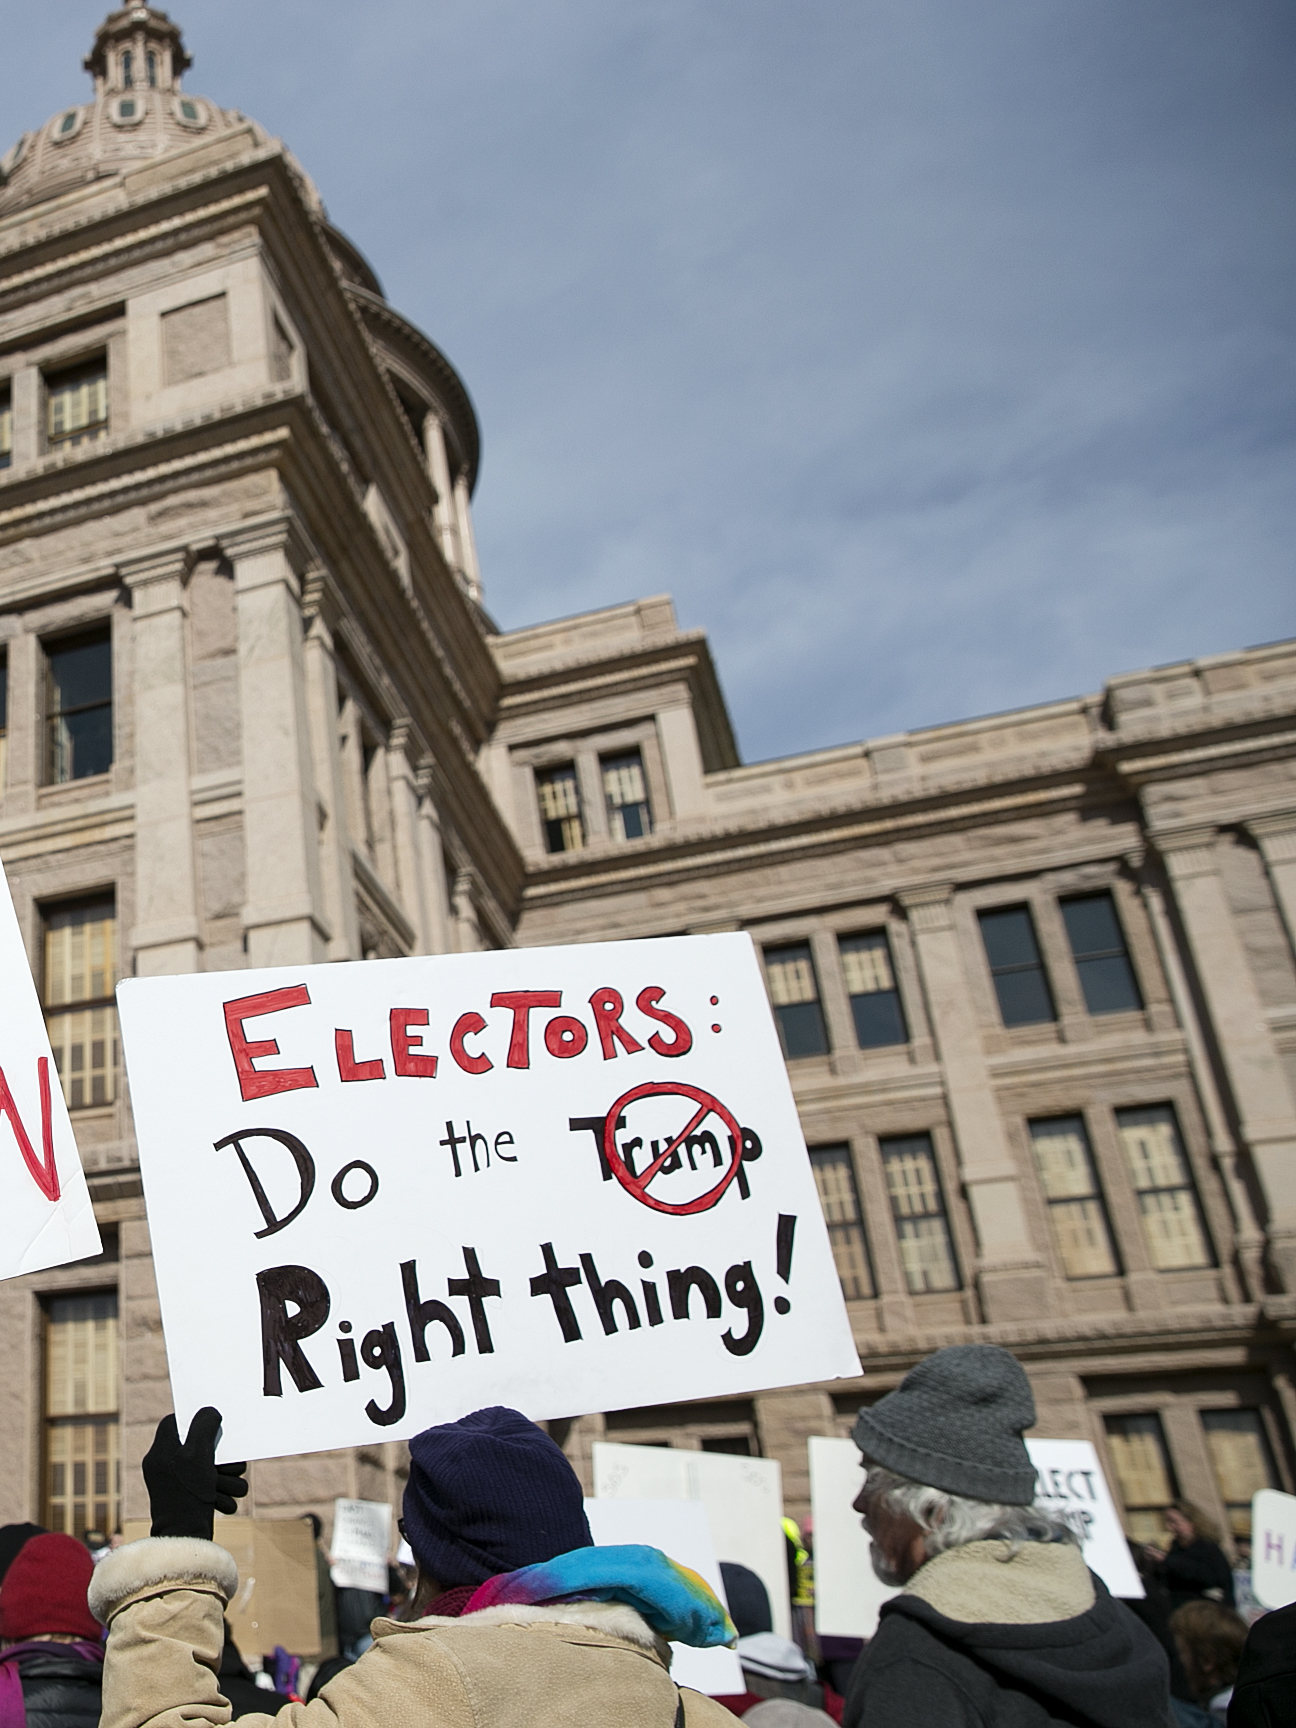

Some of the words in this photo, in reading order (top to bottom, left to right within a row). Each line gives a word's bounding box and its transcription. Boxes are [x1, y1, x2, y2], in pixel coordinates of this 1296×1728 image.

[222, 984, 722, 1102] ELECTORS:
[213, 1127, 380, 1240] Do
[439, 1120, 518, 1178] the
[568, 1115, 764, 1201] Trump
[255, 1246, 502, 1427] Right
[529, 1213, 798, 1357] thing!
[1034, 1468, 1096, 1501] LECT
